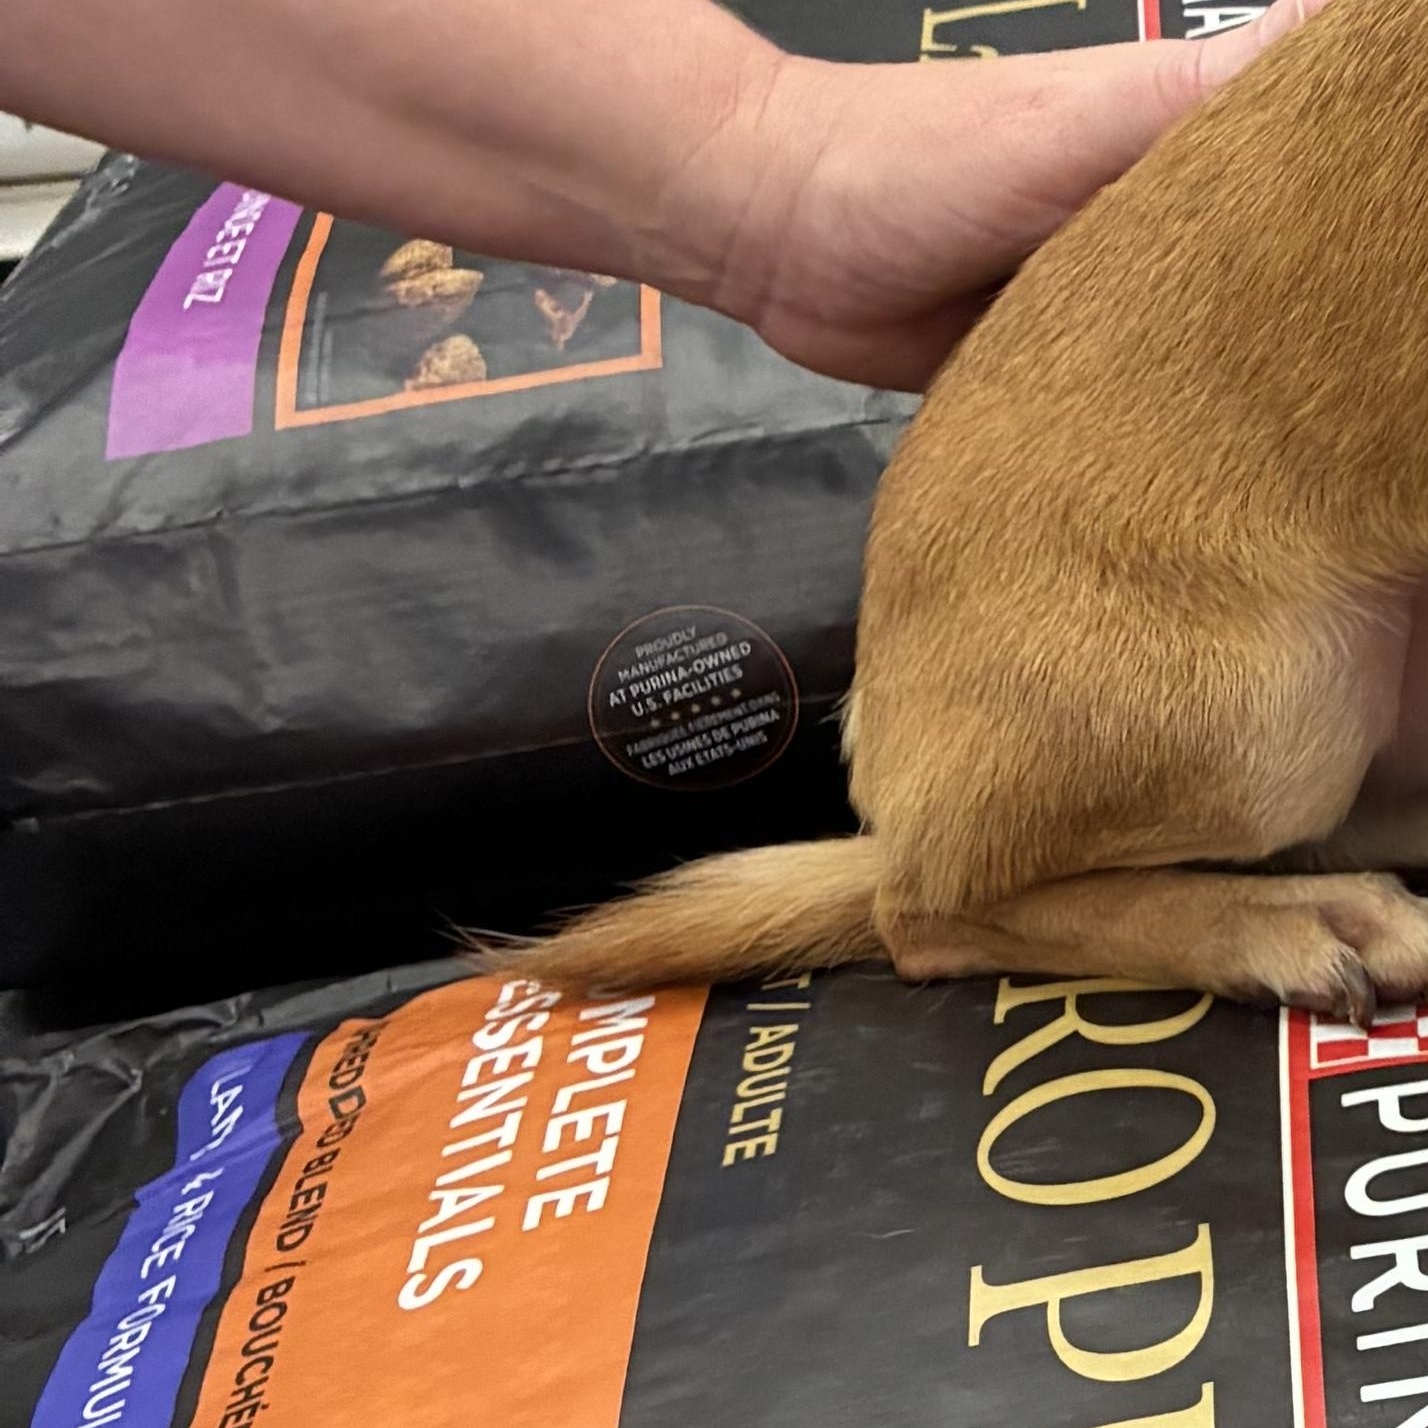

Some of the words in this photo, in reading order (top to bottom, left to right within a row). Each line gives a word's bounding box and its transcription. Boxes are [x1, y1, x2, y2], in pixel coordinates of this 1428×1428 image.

[617, 631, 728, 683] MANUFACTURED
[634, 625, 697, 659] PROUDLY
[608, 691, 627, 708] AT
[629, 640, 752, 698] PURINA-OWNED
[630, 698, 663, 718] U.S.
[663, 663, 744, 704] FACILITIES
[641, 748, 667, 770] LES
[666, 731, 713, 759] USINES
[713, 725, 730, 742] DE
[667, 758, 696, 777] AUX
[520, 988, 657, 1232] MPLETE
[721, 1023, 800, 1168] ADULTE
[275, 1147, 340, 1253] BLEND
[140, 1190, 213, 1280] RICE
